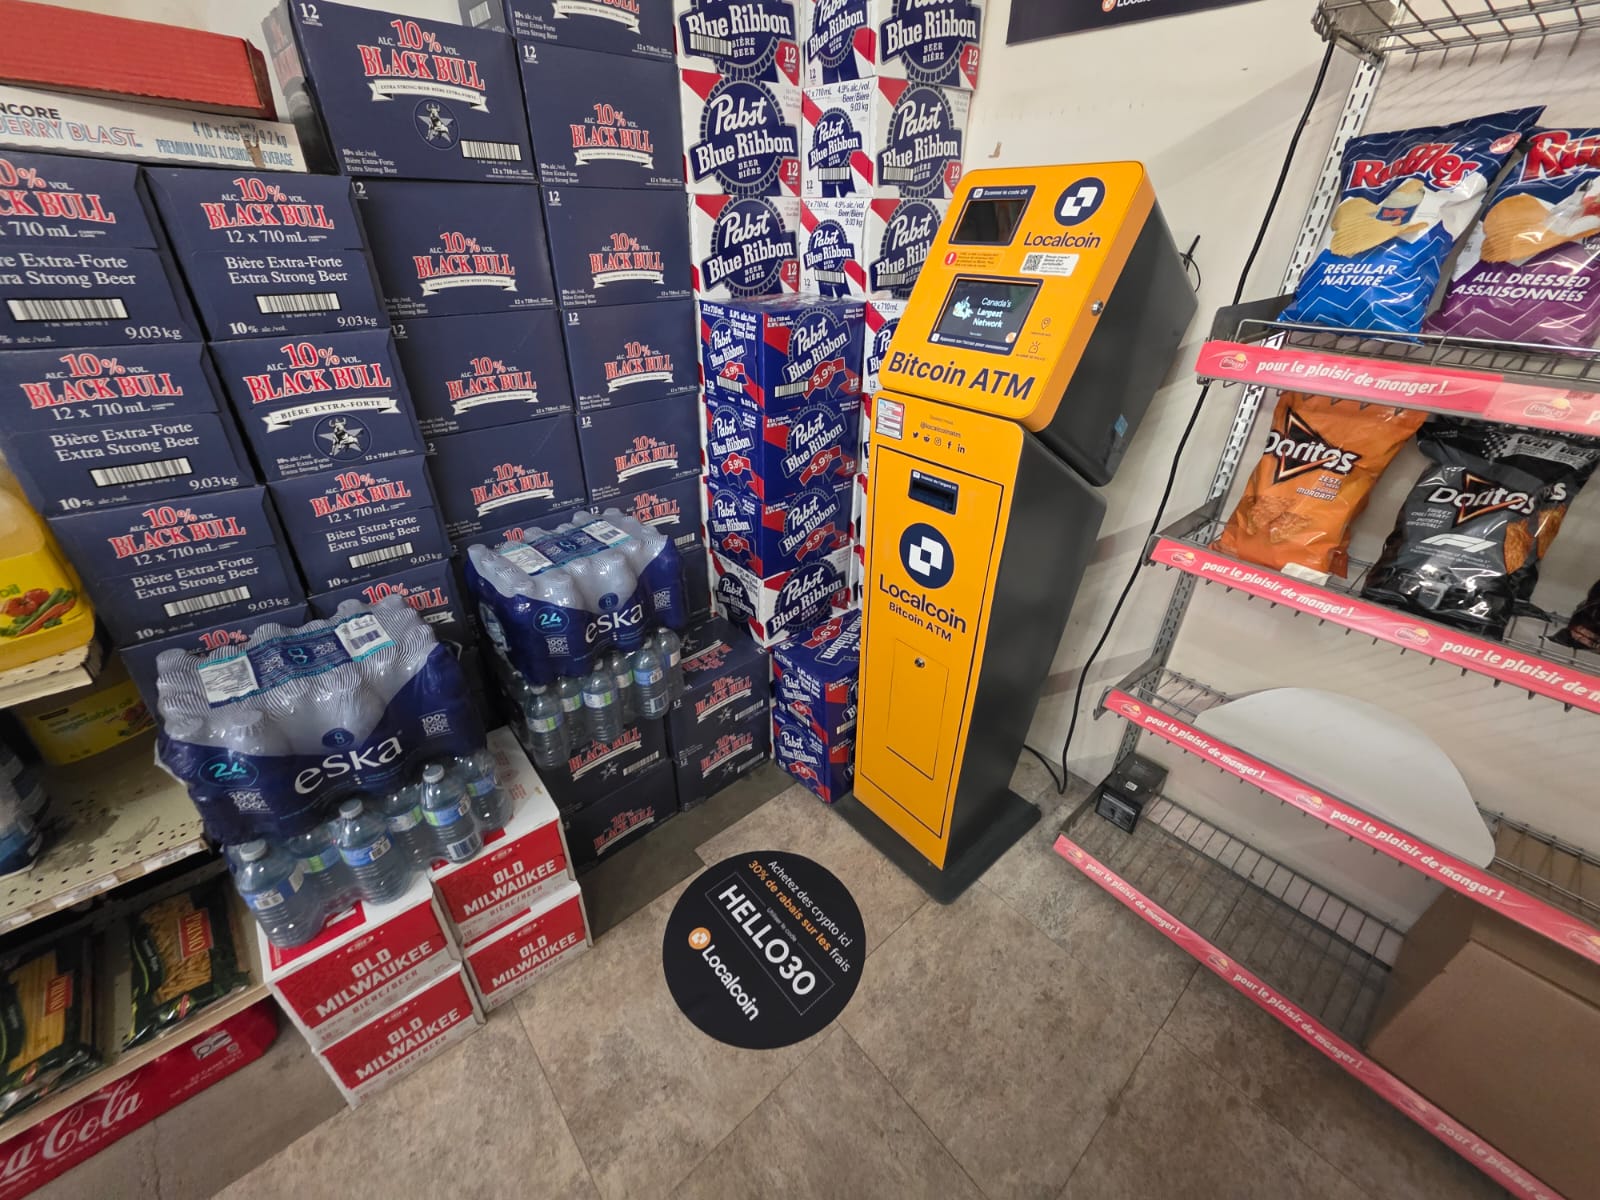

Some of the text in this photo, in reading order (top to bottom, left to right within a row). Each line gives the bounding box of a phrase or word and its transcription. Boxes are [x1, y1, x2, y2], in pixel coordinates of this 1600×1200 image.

[301, 3, 319, 19] 12
[731, 2, 792, 35] Ribbon
[391, 19, 442, 53] 10%
[810, 9, 864, 58] Blue Ribbon
[885, 9, 976, 55] Blue Ribbon
[922, 51, 945, 64] BIÈRE
[923, 42, 943, 54] BEER
[357, 44, 435, 82] BLACK
[432, 55, 485, 91] BULL
[594, 103, 626, 127] 10%
[710, 93, 768, 135] Pabst
[898, 99, 942, 141] Pabst
[570, 124, 653, 153] BLACK BULL
[817, 117, 844, 145] Pabst
[156, 139, 197, 155] PREMIUM
[198, 143, 219, 157] MALT
[260, 153, 294, 166] EVERAGE
[696, 128, 795, 175] Blue Ribbon
[810, 135, 859, 168] Blue Ribbon
[914, 131, 959, 164] Ribbon
[786, 161, 799, 177] 12
[1349, 142, 1481, 191] Ruffles
[233, 178, 287, 202] 10%
[34, 192, 116, 223] BULL
[201, 202, 335, 230] BLACK BULL
[226, 230, 307, 243] 12 710 mL
[720, 210, 770, 249] Pabst
[1023, 232, 1102, 249] Localcoin
[18, 253, 128, 269] Extra-Forte
[224, 256, 343, 269] Bière Extra-Forte
[413, 253, 515, 280] BLACK BULL
[589, 251, 664, 274] BLACK BULL
[708, 239, 794, 285] Blue Ribbon
[1323, 263, 1397, 276] REGULAR
[24, 271, 136, 288] Strong Beer
[229, 271, 348, 285] Extra Strong Beer
[1321, 274, 1384, 287] NATURE
[1451, 284, 1588, 303] ASSAISONNÉES
[1472, 271, 1592, 288] ALL DRESSED
[976, 307, 1004, 318] Largest
[981, 297, 1012, 308] Canada's
[337, 315, 378, 328] 9.03 kg
[793, 317, 829, 356] Pabst
[972, 317, 1004, 329] Network
[712, 328, 733, 350] Pabst
[59, 353, 125, 378] 10%
[266, 342, 362, 372] ALC. 10% VOL.
[786, 331, 848, 383] Blue Ribbon
[242, 363, 391, 404] BLACK BULL
[812, 364, 837, 386] 5.9%
[887, 350, 1036, 401] Bitcoin ATM
[1256, 361, 1290, 374] pour
[1290, 361, 1305, 373] le
[1304, 363, 1352, 383] plaisir
[1353, 372, 1375, 387] de
[20, 373, 184, 410] BLACK BULL
[280, 398, 382, 420] BIÈRE EXTRA-FORTE
[49, 422, 193, 448] Bière Extra-Forte
[791, 412, 825, 450] Pabst
[55, 435, 201, 462] Extra Strong Beer
[785, 423, 843, 475] Blue Ribbon
[1264, 431, 1359, 473] Doritos
[189, 475, 239, 491] 9.03 kg
[309, 480, 412, 518] BLACK BULL
[1427, 487, 1536, 515] Doritos
[108, 516, 247, 559] BLACK BULL
[782, 566, 825, 607] Pabst
[1201, 561, 1229, 575] pour
[1230, 566, 1242, 578] le
[1241, 571, 1282, 592] plaisir
[1281, 587, 1297, 601] de
[539, 613, 562, 625] 24
[772, 577, 843, 634] Blue Ribbon
[879, 573, 967, 634] Localcoin
[585, 603, 643, 644] eska
[888, 601, 952, 643] Bitcoin ATM
[1145, 713, 1169, 730] pour
[1169, 722, 1179, 734] le
[1178, 727, 1209, 752] plaisir
[1208, 745, 1221, 758] de
[209, 762, 247, 779] 24
[295, 734, 404, 796] eska
[463, 859, 557, 917] MILWAUKEE
[492, 860, 525, 886] OLD
[748, 859, 851, 973] 30% de rabais sur les frais
[767, 859, 853, 949] Achetez des crypto ici
[519, 934, 548, 959] OLD
[718, 884, 817, 996] HELLO30
[351, 947, 392, 979] OLD
[491, 931, 577, 989] MILWAUKEE
[316, 940, 433, 1019] MILWAUKEE
[701, 944, 761, 1022] Localcoin
[355, 1007, 461, 1082] MILWAUKEE
[387, 1016, 423, 1047] OLD
